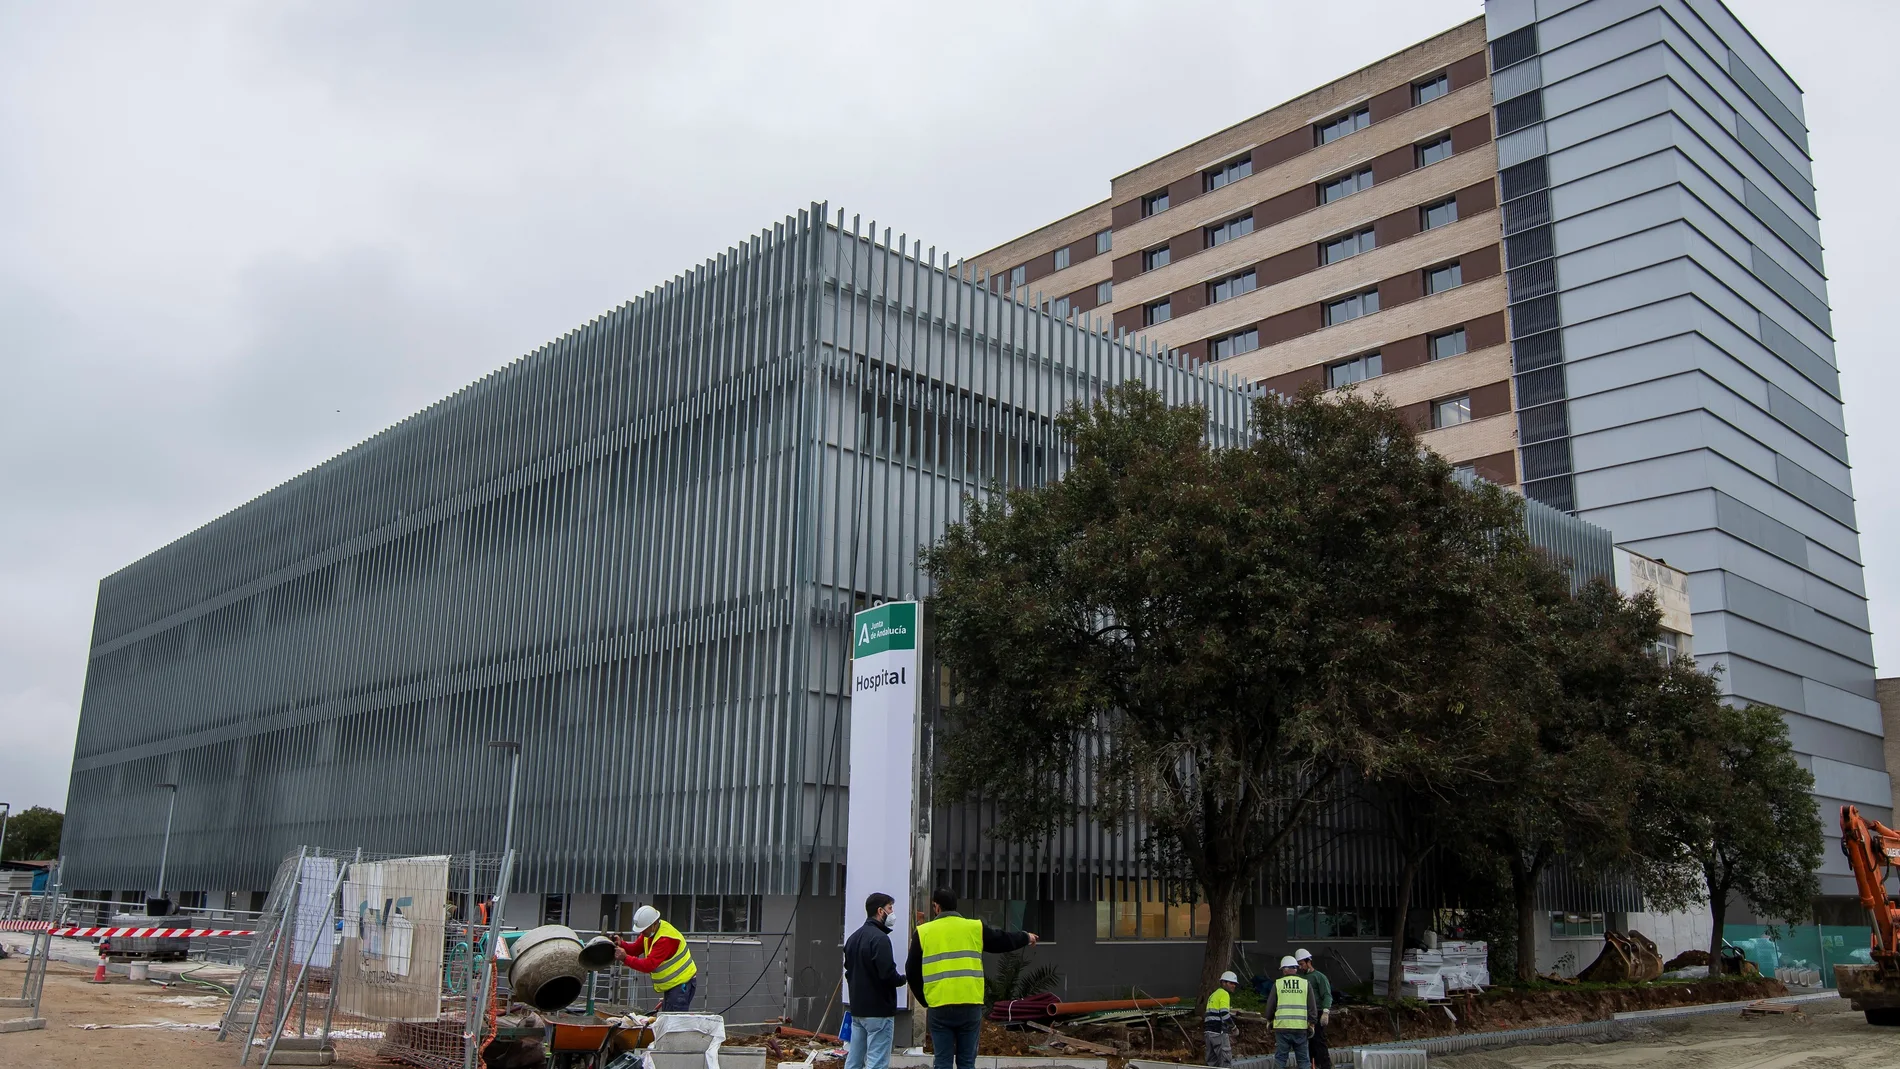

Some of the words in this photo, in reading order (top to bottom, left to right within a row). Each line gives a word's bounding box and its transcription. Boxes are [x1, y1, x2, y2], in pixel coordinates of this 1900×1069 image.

[871, 621, 884, 630] Junta
[871, 632, 877, 640] de
[877, 625, 906, 637] Andalucía
[856, 667, 906, 692] Hospital
[1283, 980, 1300, 989] MH
